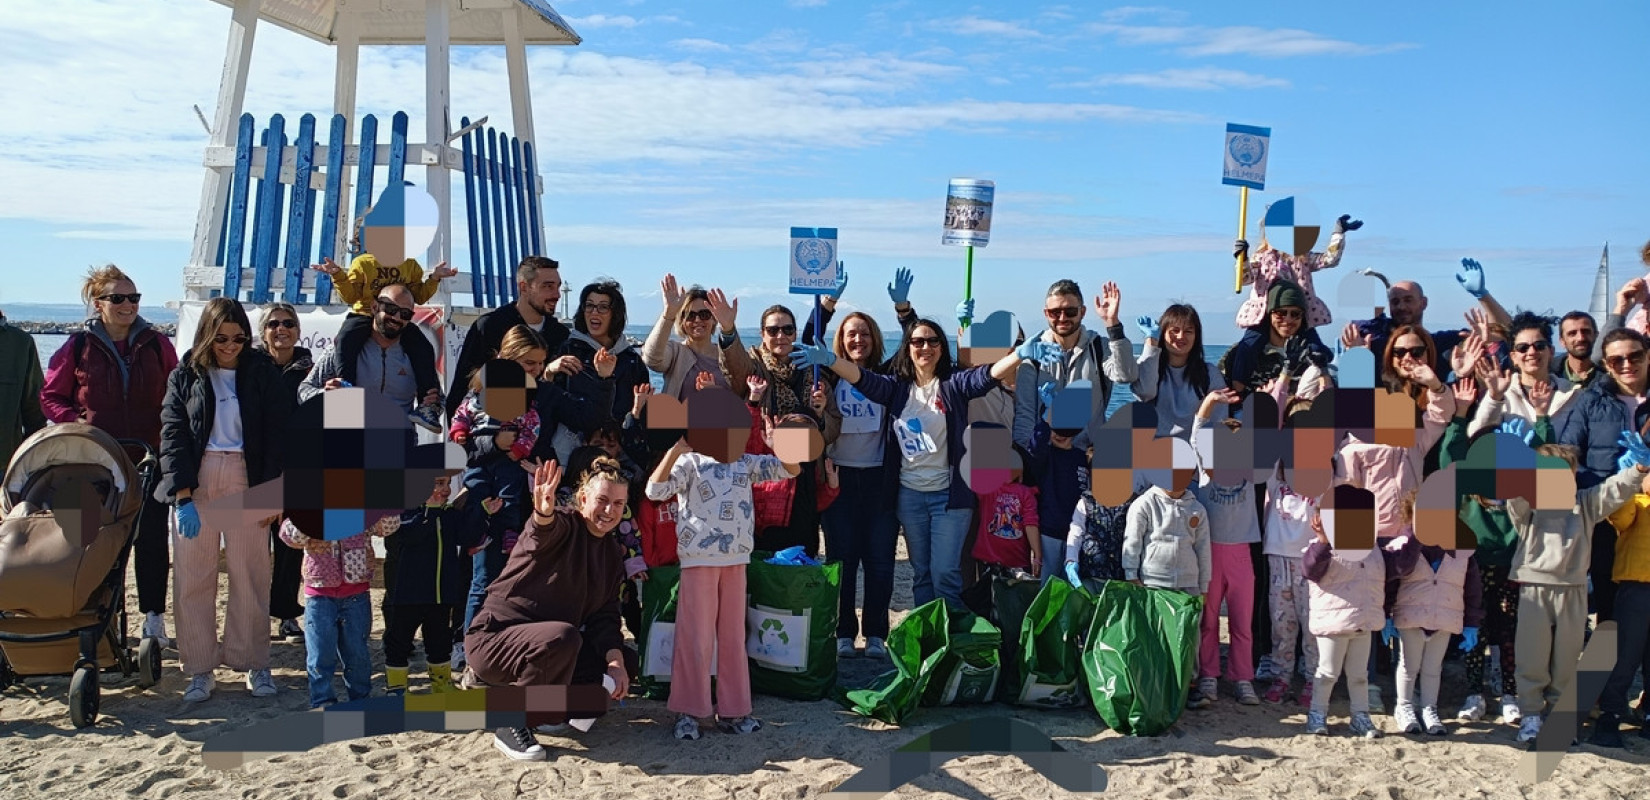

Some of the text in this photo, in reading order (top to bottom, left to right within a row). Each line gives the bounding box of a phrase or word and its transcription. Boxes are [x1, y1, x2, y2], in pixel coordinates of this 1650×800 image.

[376, 266, 401, 279] NO
[790, 277, 837, 288] HELMEPA
[840, 388, 848, 402] I
[840, 403, 876, 418] SEA
[898, 425, 907, 441] I
